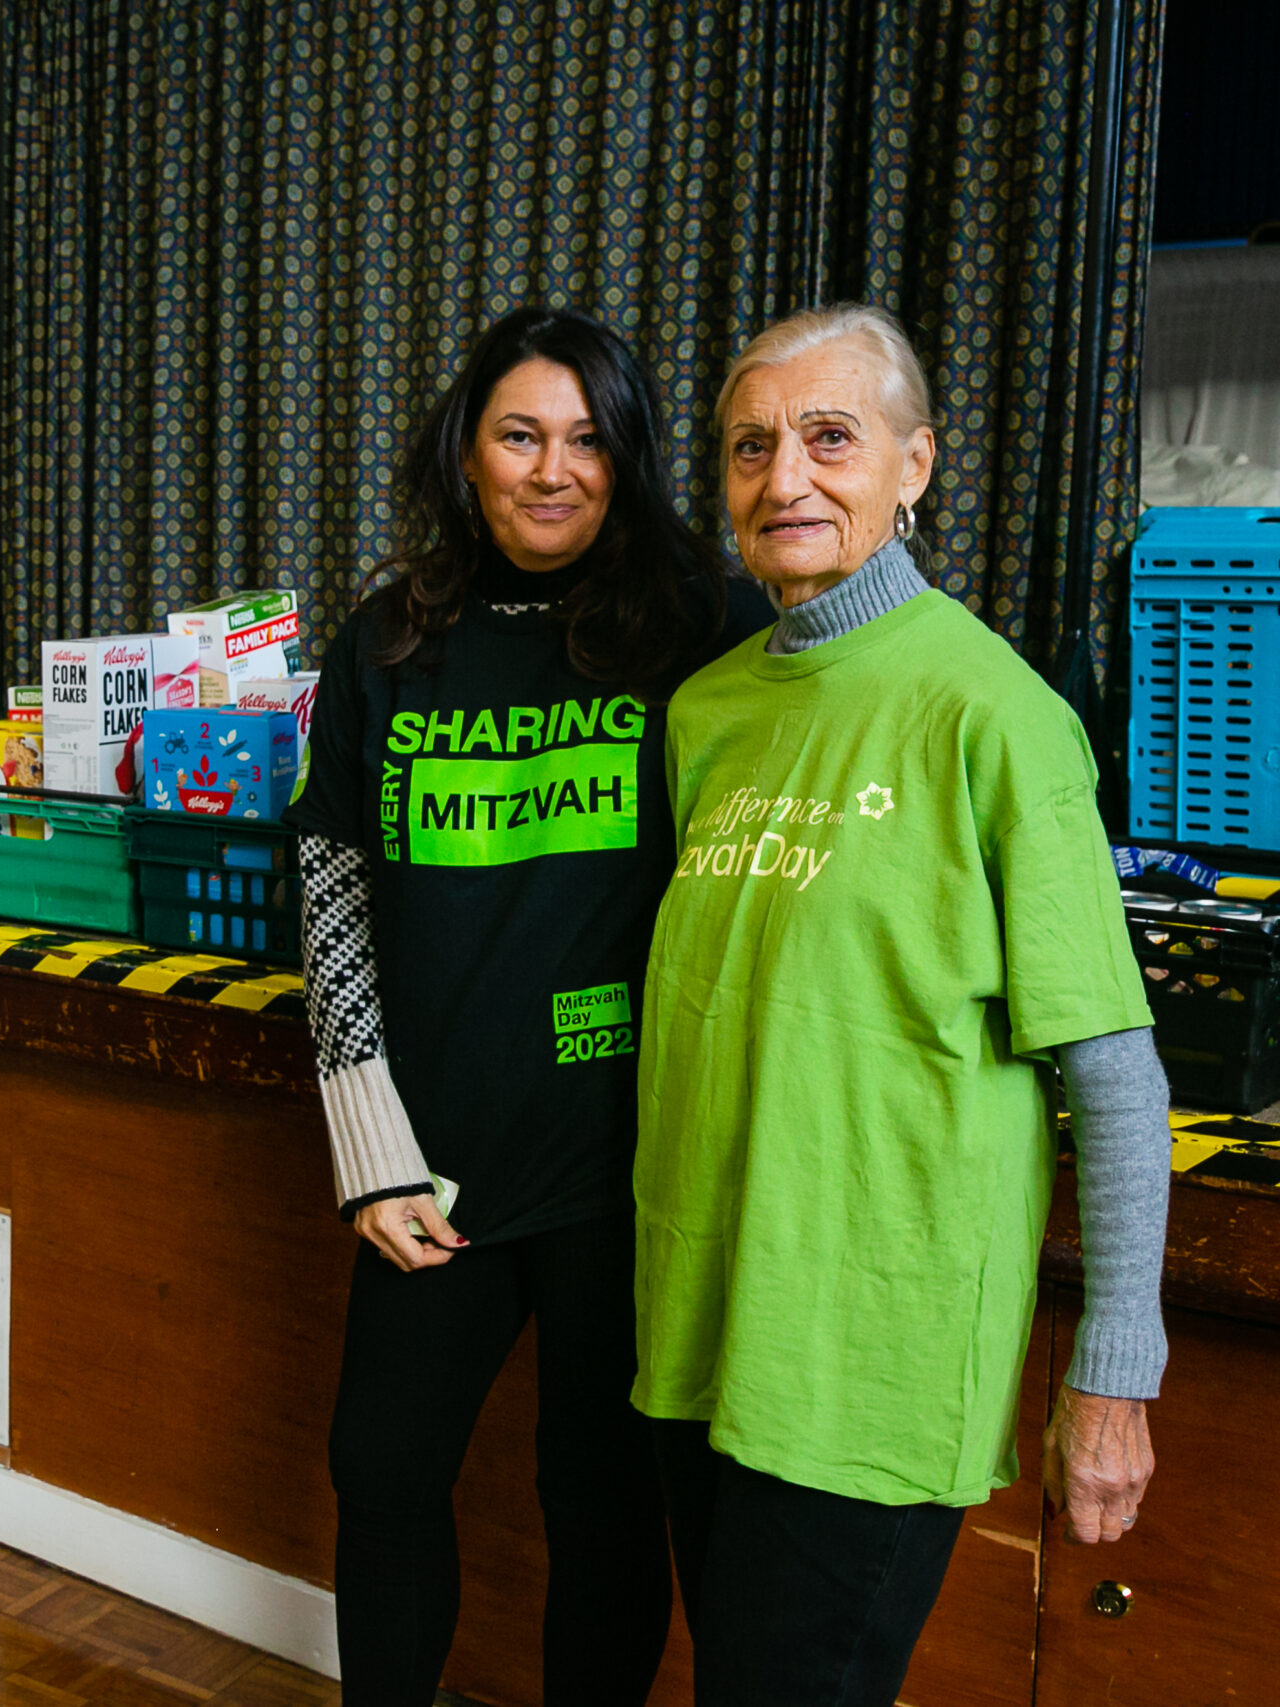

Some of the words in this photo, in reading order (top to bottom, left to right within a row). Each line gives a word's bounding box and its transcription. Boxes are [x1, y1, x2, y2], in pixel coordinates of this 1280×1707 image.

[227, 627, 269, 655] FAMILY
[271, 617, 297, 641] PACK
[103, 646, 147, 667] Kellogg's
[52, 665, 87, 685] CORN
[52, 687, 87, 703] FLAKES
[103, 668, 148, 705] CORN
[238, 693, 287, 711] Kellogg's
[200, 722, 210, 739] 2
[387, 694, 646, 754] SHARING
[152, 758, 159, 773] 1
[251, 765, 262, 782] 3
[380, 761, 403, 861] EVERY
[421, 775, 622, 831] MITZVAH
[557, 987, 625, 1011] Mitzvah
[558, 1011, 591, 1027] Day
[556, 1027, 635, 1065] 2022
